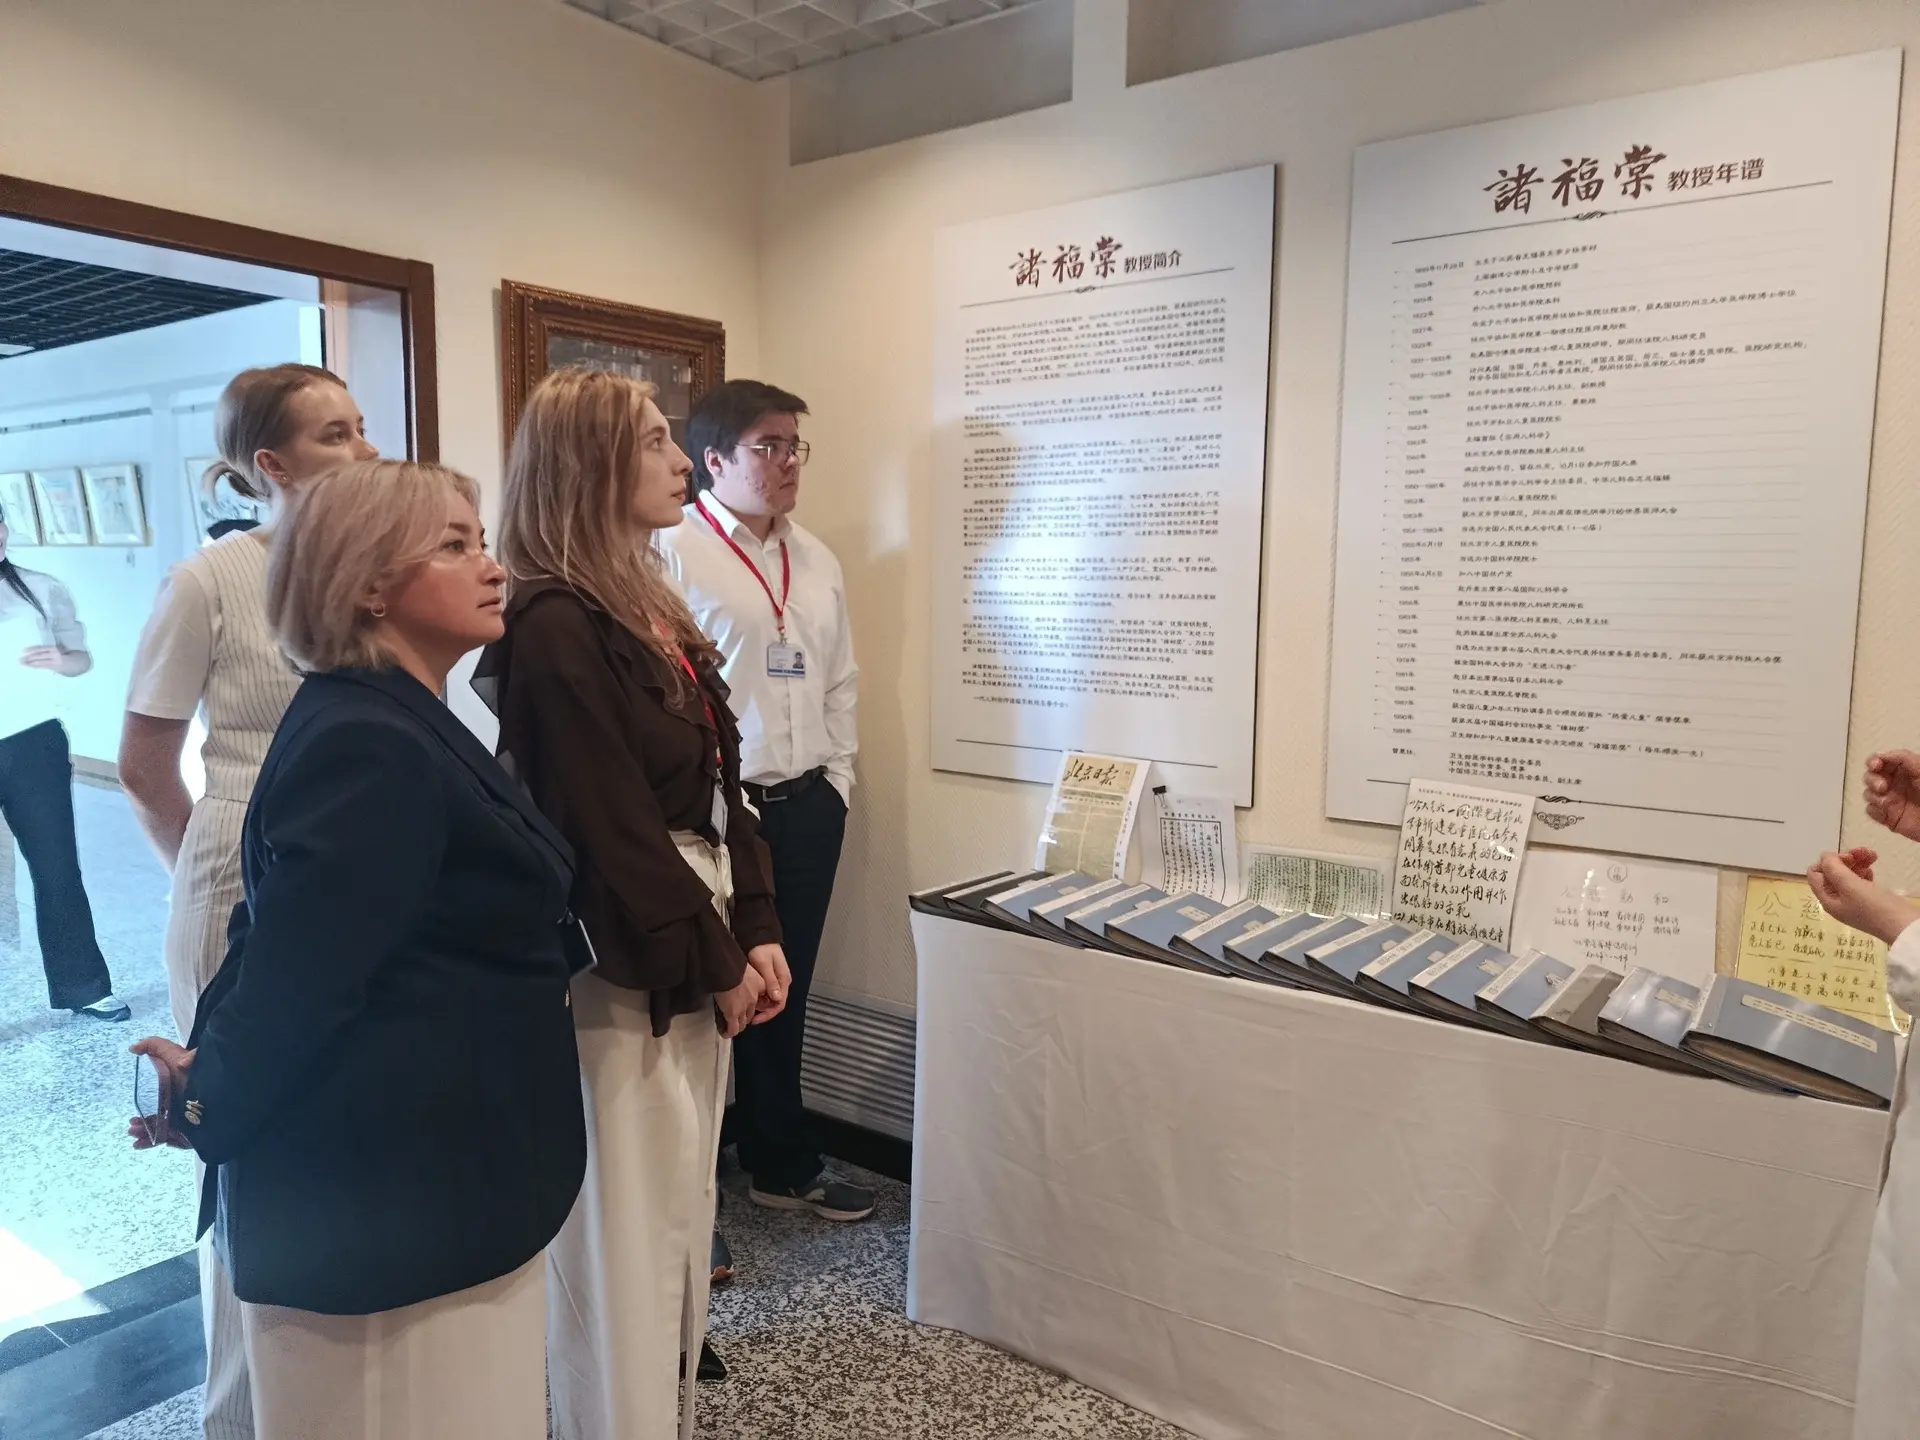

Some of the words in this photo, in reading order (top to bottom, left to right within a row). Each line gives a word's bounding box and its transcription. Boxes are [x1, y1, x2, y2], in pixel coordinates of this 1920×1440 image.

[1668, 157, 1766, 193] 教授年谱
[1124, 249, 1183, 274] 教授简介
[1758, 892, 1791, 918] 公
